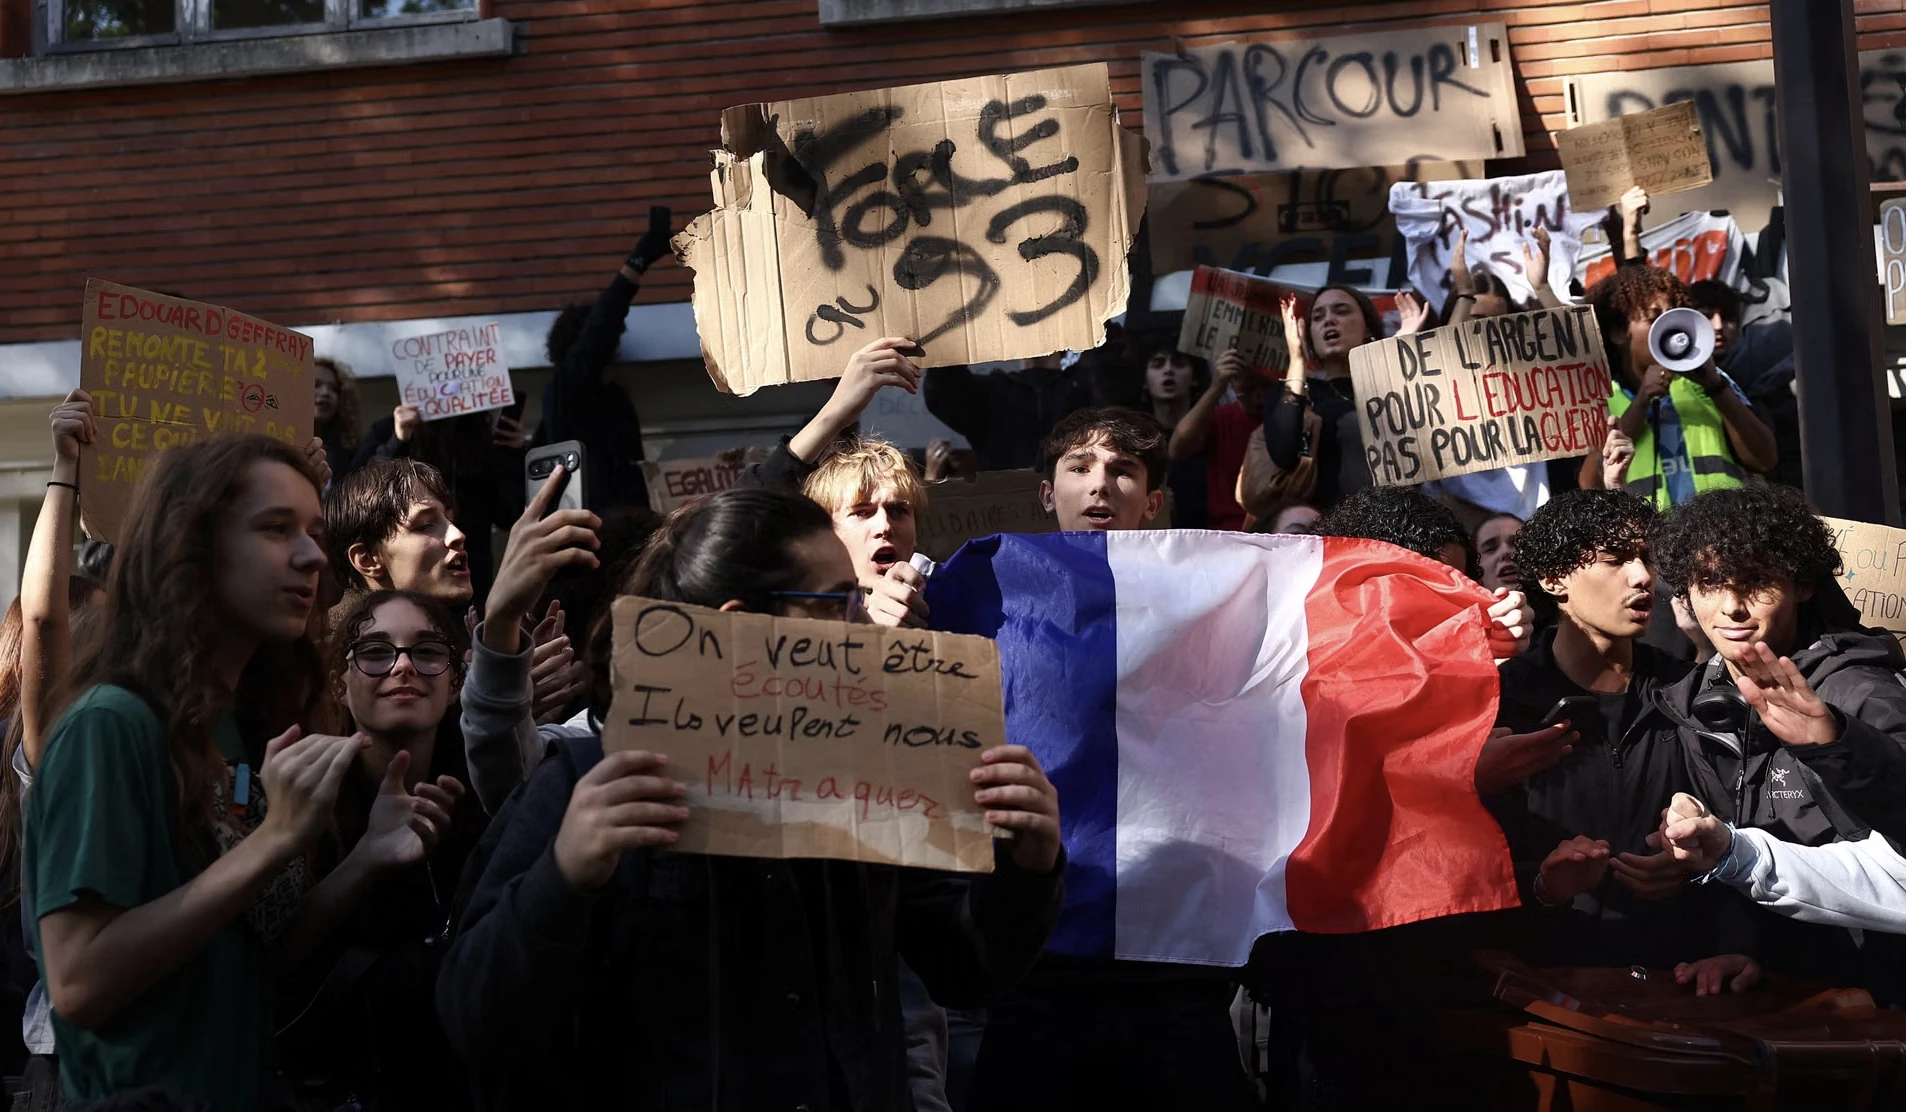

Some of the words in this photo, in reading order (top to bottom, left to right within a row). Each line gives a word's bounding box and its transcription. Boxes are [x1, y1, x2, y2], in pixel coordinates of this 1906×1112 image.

[1156, 43, 1491, 176] PARCOUR
[893, 194, 1100, 358] 93
[89, 325, 213, 369] REMONTE
[218, 344, 249, 377] TA
[98, 290, 223, 336] EDOUARD
[226, 315, 309, 361] GEFFRAY
[391, 321, 500, 361] CONTRAINT
[1396, 330, 1442, 382] DE
[1453, 306, 1592, 370] L'ARGENT
[413, 356, 436, 375] DE
[444, 347, 497, 370] PAYER
[90, 389, 138, 419] TU
[149, 399, 193, 426] NE
[112, 421, 149, 450] CE
[1365, 381, 1446, 441] POUR
[1366, 436, 1421, 487] PAS
[1430, 419, 1508, 472] POUR
[1508, 414, 1543, 455] LA
[635, 604, 723, 660] On
[765, 633, 865, 675] veut
[882, 638, 979, 680] être
[628, 683, 704, 732] Ils
[882, 722, 983, 750] nous
[731, 659, 888, 713] écoutés
